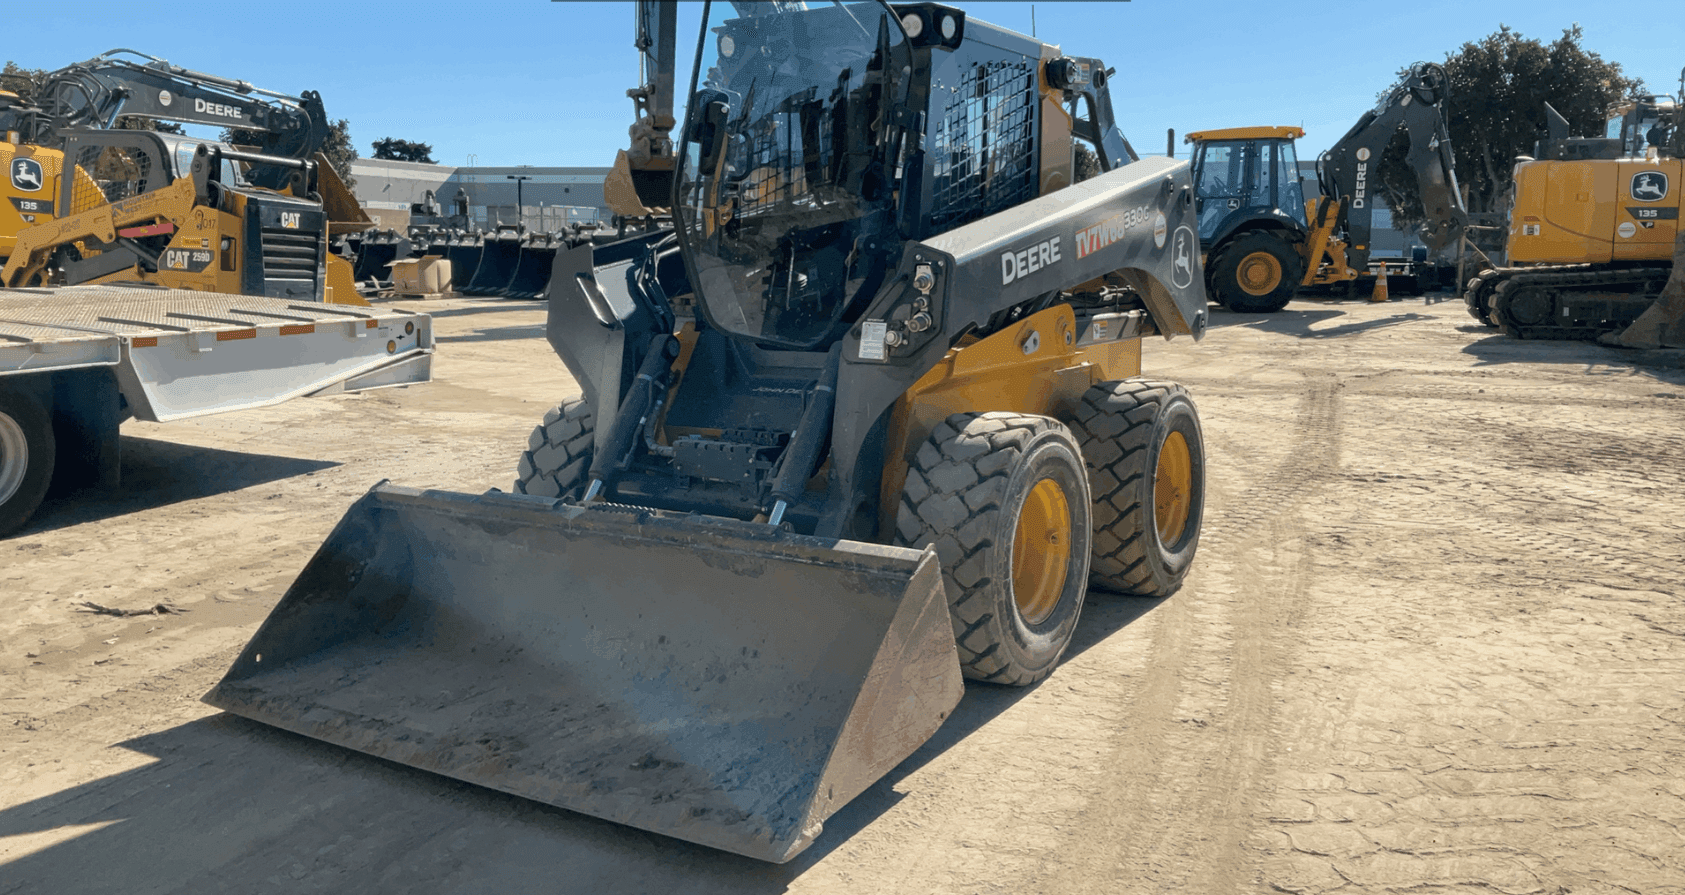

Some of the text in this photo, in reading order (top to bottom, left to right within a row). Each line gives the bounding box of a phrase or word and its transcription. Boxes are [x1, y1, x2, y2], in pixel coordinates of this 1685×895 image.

[195, 98, 242, 118] DEERE
[1353, 163, 1367, 208] DEERE
[20, 201, 37, 210] 135
[281, 212, 300, 229] CAT
[1124, 205, 1149, 229] 330G
[167, 250, 190, 269] CAT
[1002, 236, 1061, 285] DEERE
